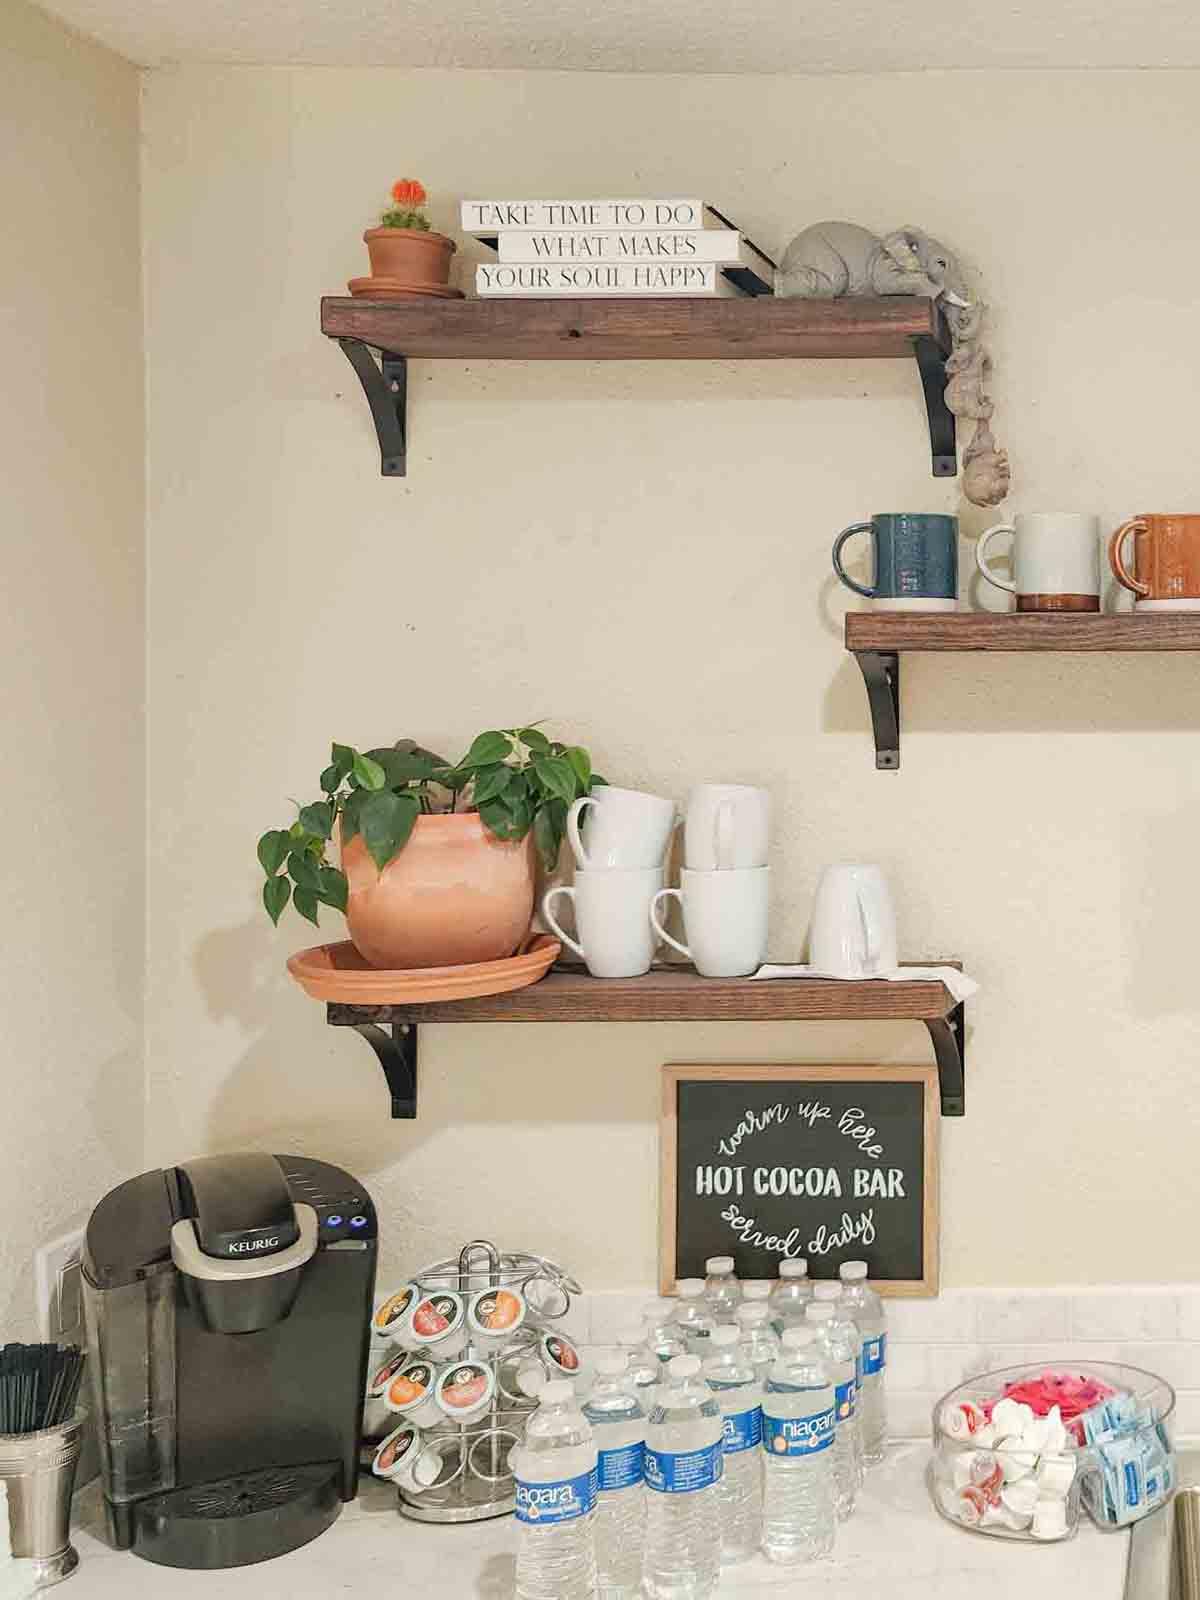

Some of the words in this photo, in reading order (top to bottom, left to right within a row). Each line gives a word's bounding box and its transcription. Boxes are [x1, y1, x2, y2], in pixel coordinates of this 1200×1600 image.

[472, 205, 534, 225] TAKE
[542, 205, 601, 225] TIME
[608, 205, 645, 225] TO
[655, 204, 694, 225] DO
[531, 236, 608, 257] WHAT
[618, 236, 697, 257] MAKES
[480, 267, 552, 288] YOUR
[559, 267, 624, 288] SOUL
[633, 267, 710, 288] HAPPY
[717, 1102, 790, 1156] warm
[798, 1100, 832, 1126] up
[838, 1107, 884, 1159] here
[695, 1165, 747, 1195] HOT
[753, 1166, 842, 1197] COCOA
[853, 1168, 905, 1198] BAR
[720, 1203, 801, 1257] served
[808, 1207, 876, 1254] daily
[228, 1236, 280, 1253] KEURIG
[782, 1412, 834, 1437] niagar
[516, 1484, 574, 1505] iagara
